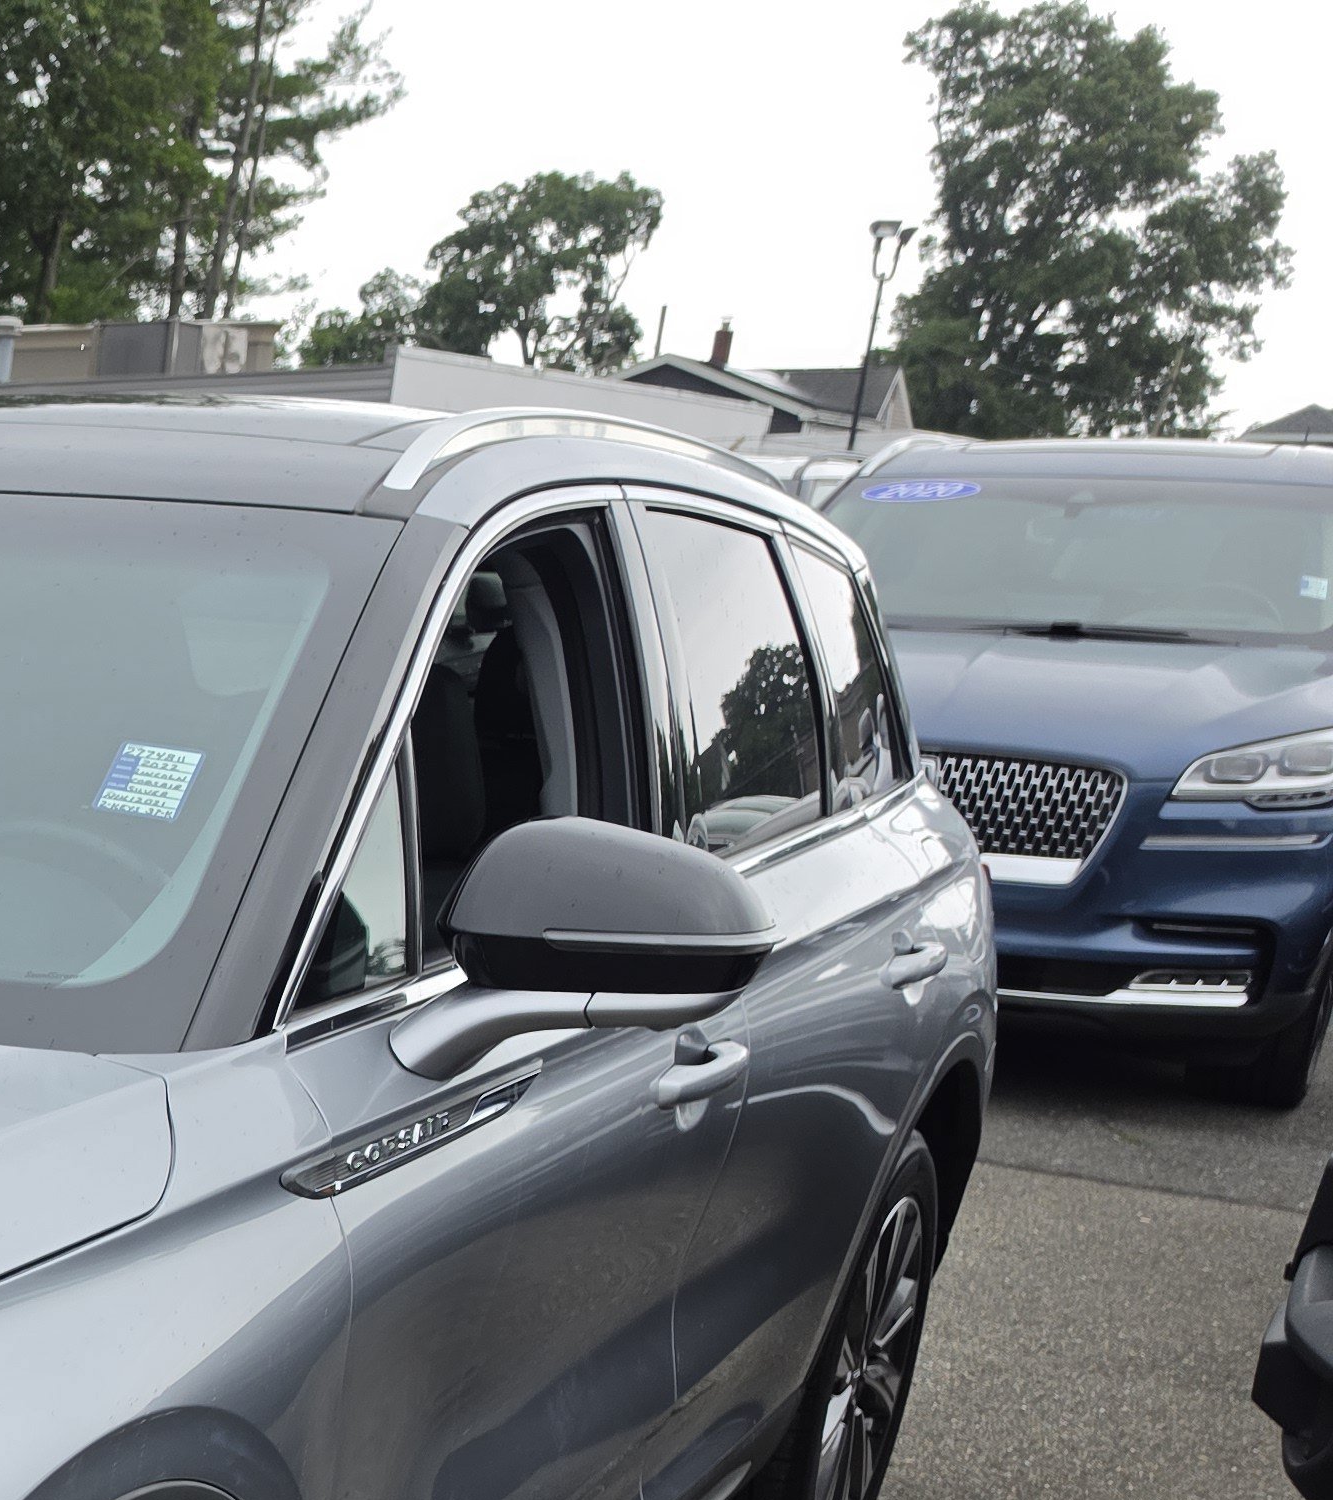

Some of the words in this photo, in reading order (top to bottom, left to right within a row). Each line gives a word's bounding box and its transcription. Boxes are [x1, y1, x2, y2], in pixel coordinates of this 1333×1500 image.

[876, 482, 965, 499] 2020
[133, 768, 188, 782] LINCOLN
[346, 1111, 449, 1172] CORSAIR
